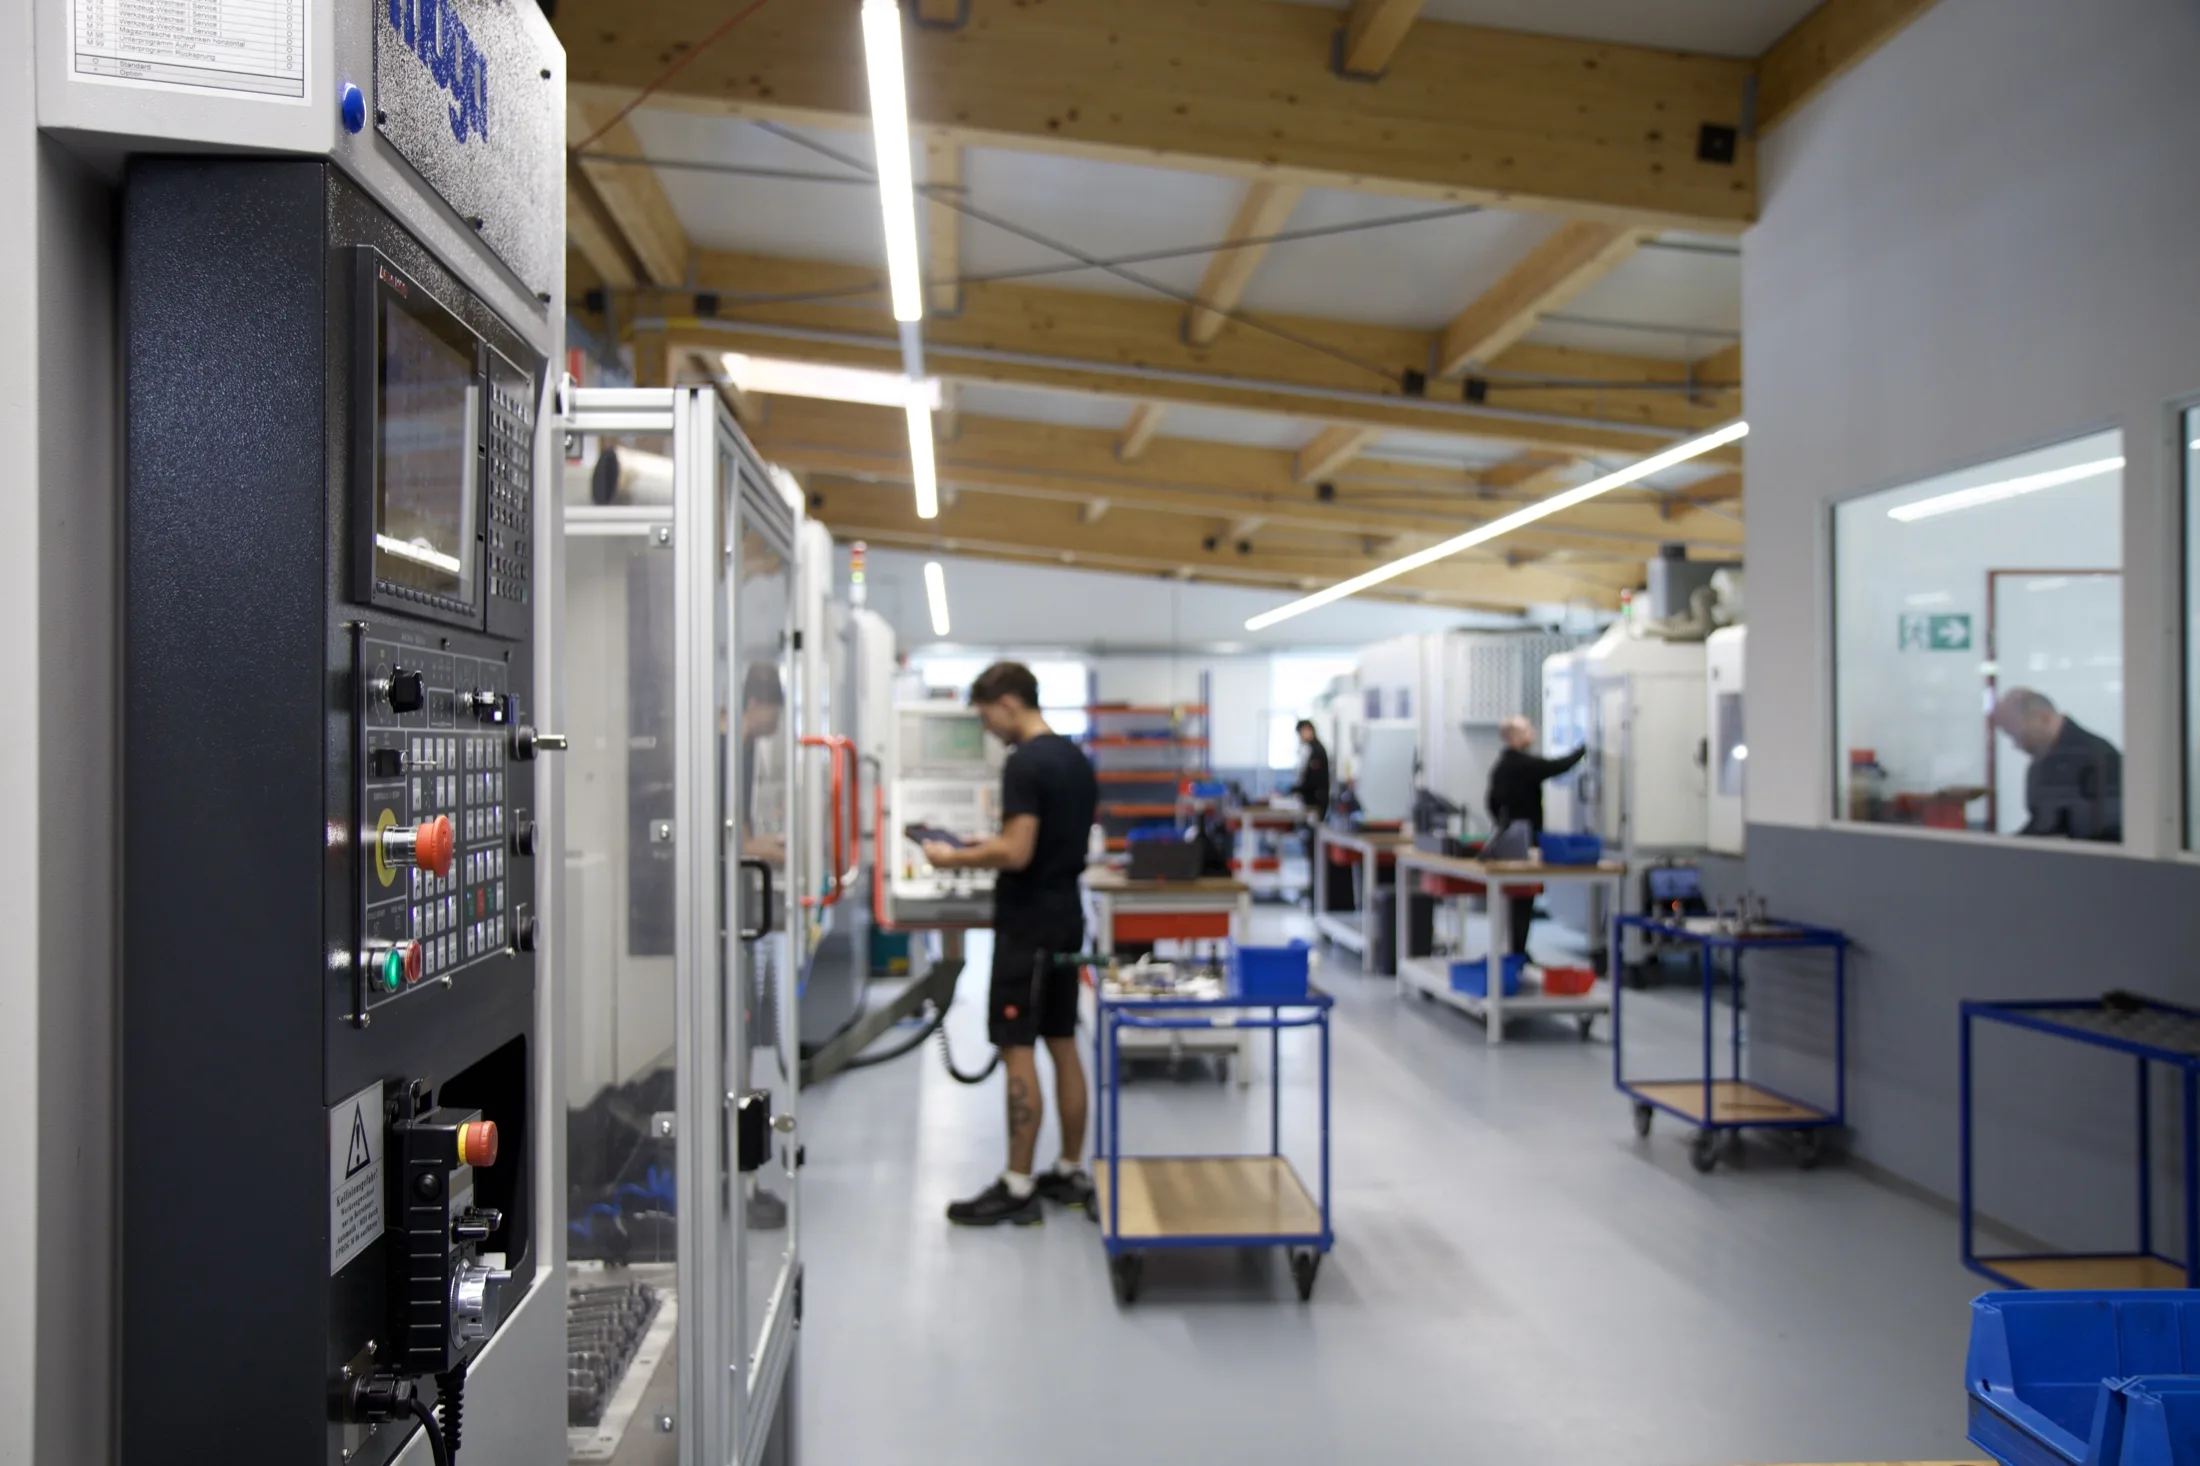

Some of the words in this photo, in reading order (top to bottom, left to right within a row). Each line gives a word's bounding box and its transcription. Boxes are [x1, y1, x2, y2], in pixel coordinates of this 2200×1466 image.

[119, 35, 174, 47] Unterprogramm
[119, 43, 174, 55] Unterprogramm
[119, 60, 152, 71] Standard
[119, 69, 143, 77] Option
[336, 1168, 378, 1207] Kollisionsgefahr!
